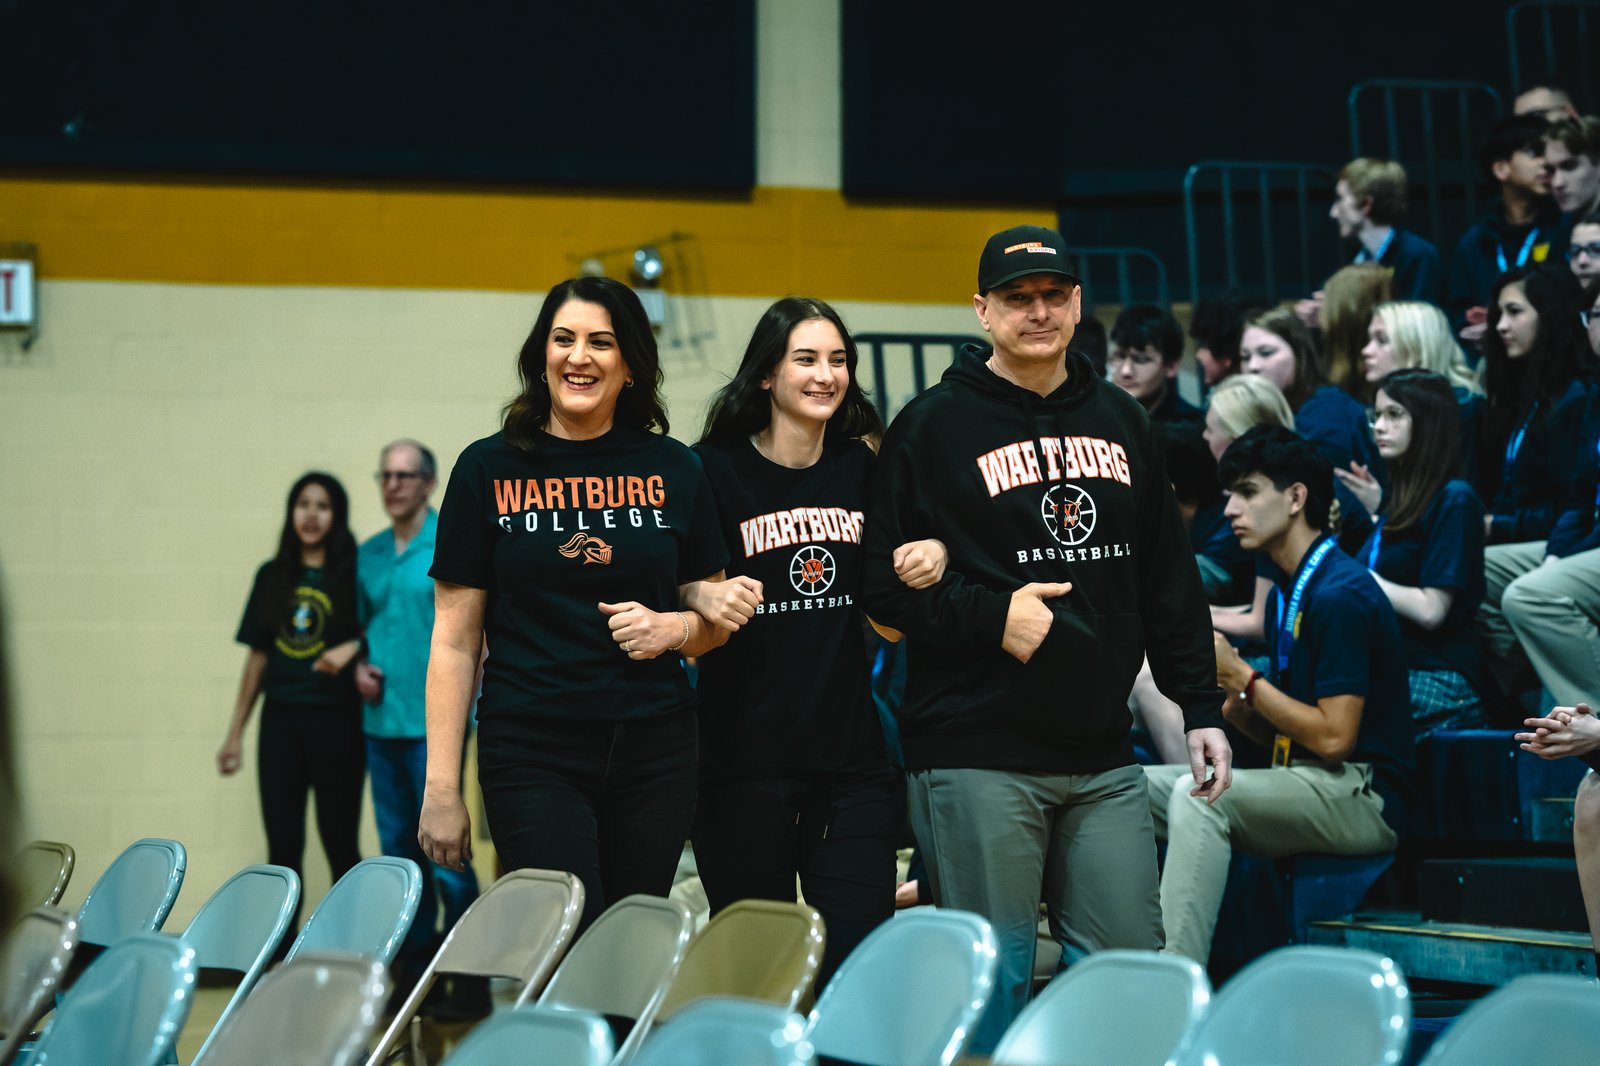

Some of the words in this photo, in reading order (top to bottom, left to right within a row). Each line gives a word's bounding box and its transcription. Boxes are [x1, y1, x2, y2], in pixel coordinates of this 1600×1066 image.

[976, 436, 1131, 497] WARTBURG
[494, 475, 666, 514] WARTBURG
[499, 508, 670, 532] COLLEGE
[756, 595, 853, 614] BASKETBAL
